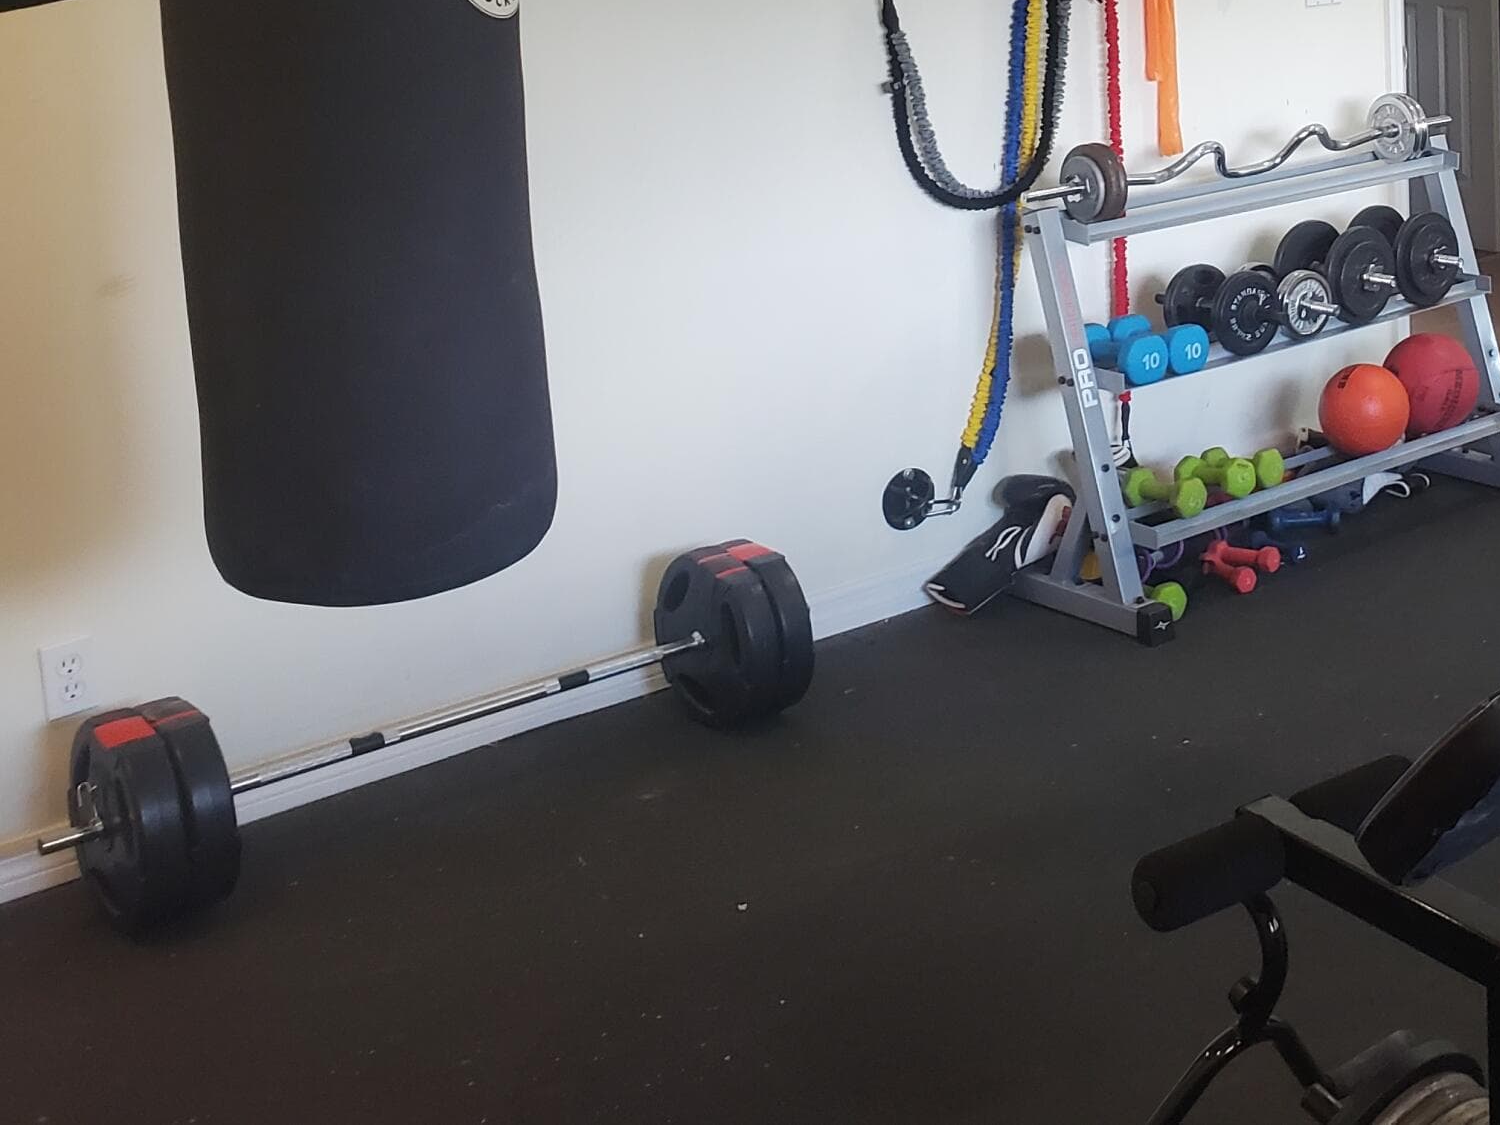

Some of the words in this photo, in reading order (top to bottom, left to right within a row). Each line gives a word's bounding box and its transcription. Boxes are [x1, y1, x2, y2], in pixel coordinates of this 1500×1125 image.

[1184, 342, 1201, 360] 10
[1142, 352, 1160, 371] 10
[1072, 348, 1099, 408] PRO
